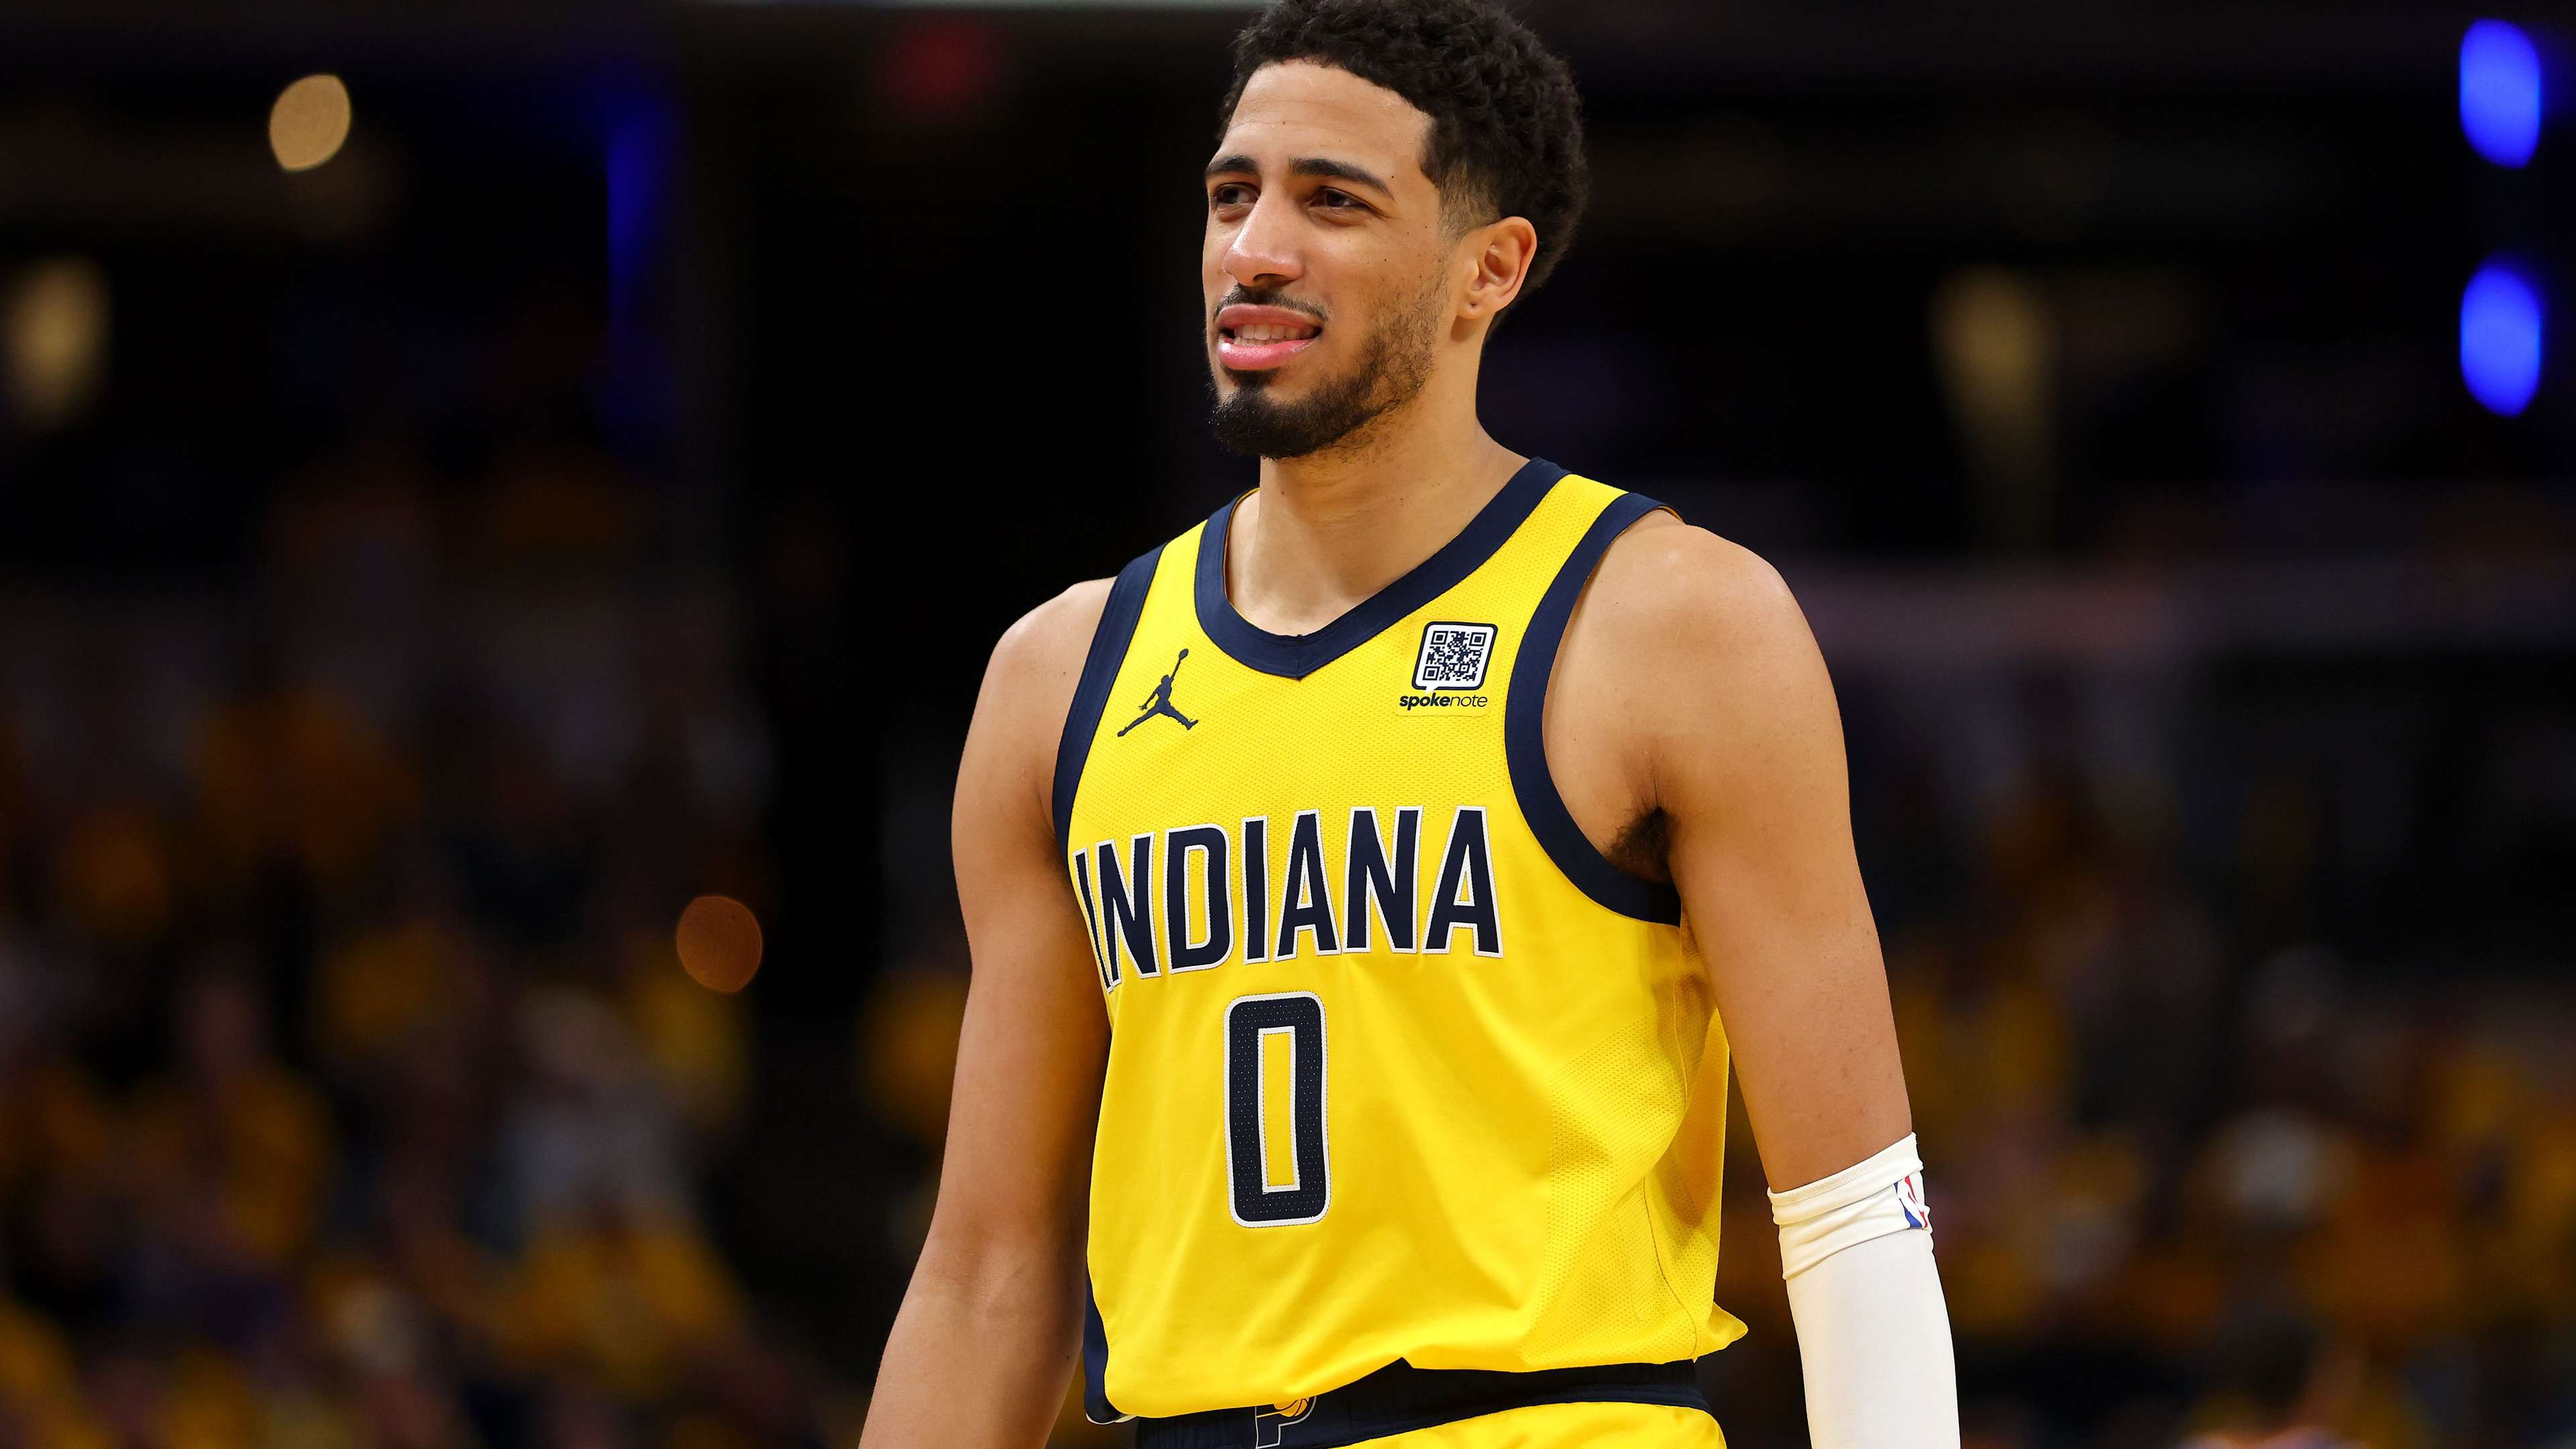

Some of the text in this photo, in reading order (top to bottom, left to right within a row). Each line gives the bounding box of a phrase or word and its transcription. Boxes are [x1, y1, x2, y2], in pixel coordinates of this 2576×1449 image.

[1399, 692, 1488, 711] spokenote
[1073, 805, 1504, 993] INDIANA
[1224, 990, 1331, 1228] 0
